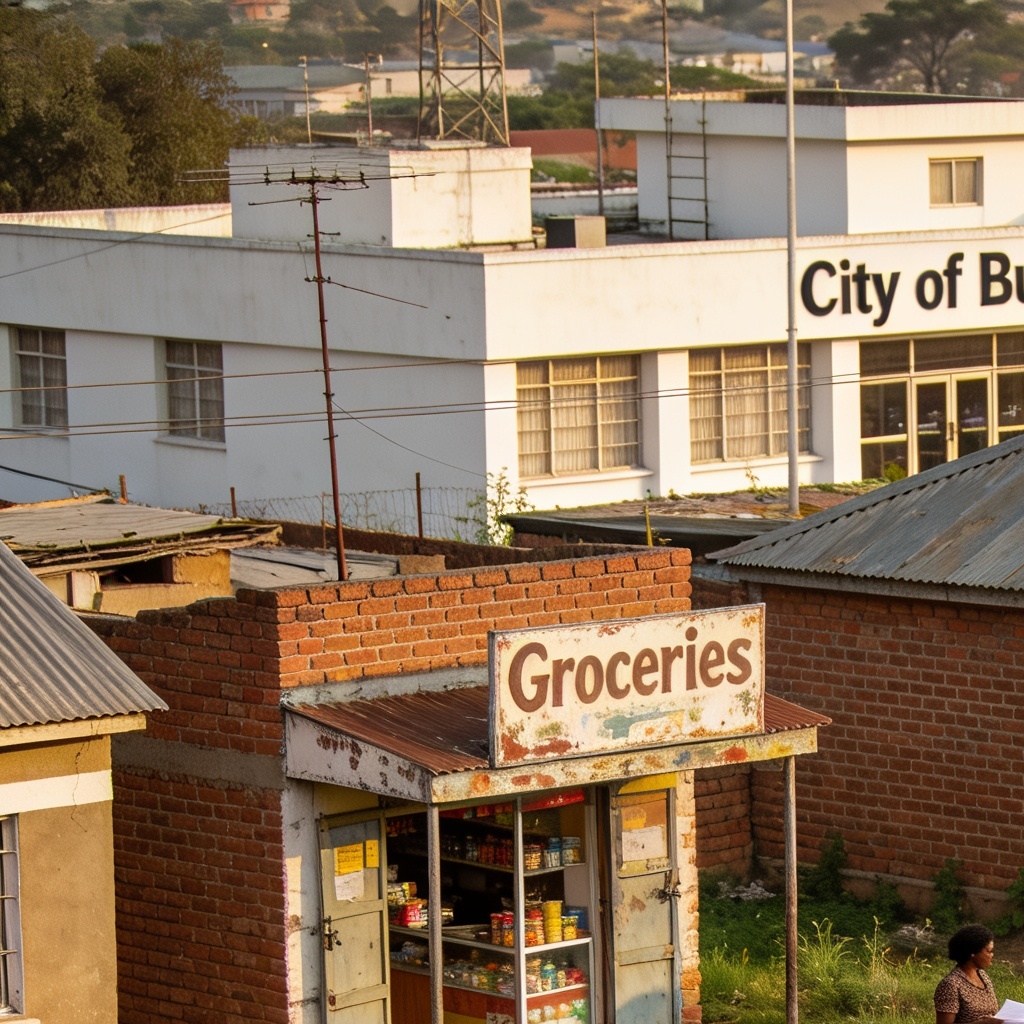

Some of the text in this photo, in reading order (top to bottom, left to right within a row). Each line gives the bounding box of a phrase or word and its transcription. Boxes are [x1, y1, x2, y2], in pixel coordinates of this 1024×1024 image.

[800, 259, 900, 327] City
[915, 252, 964, 309] of
[508, 626, 752, 713] Groceries
